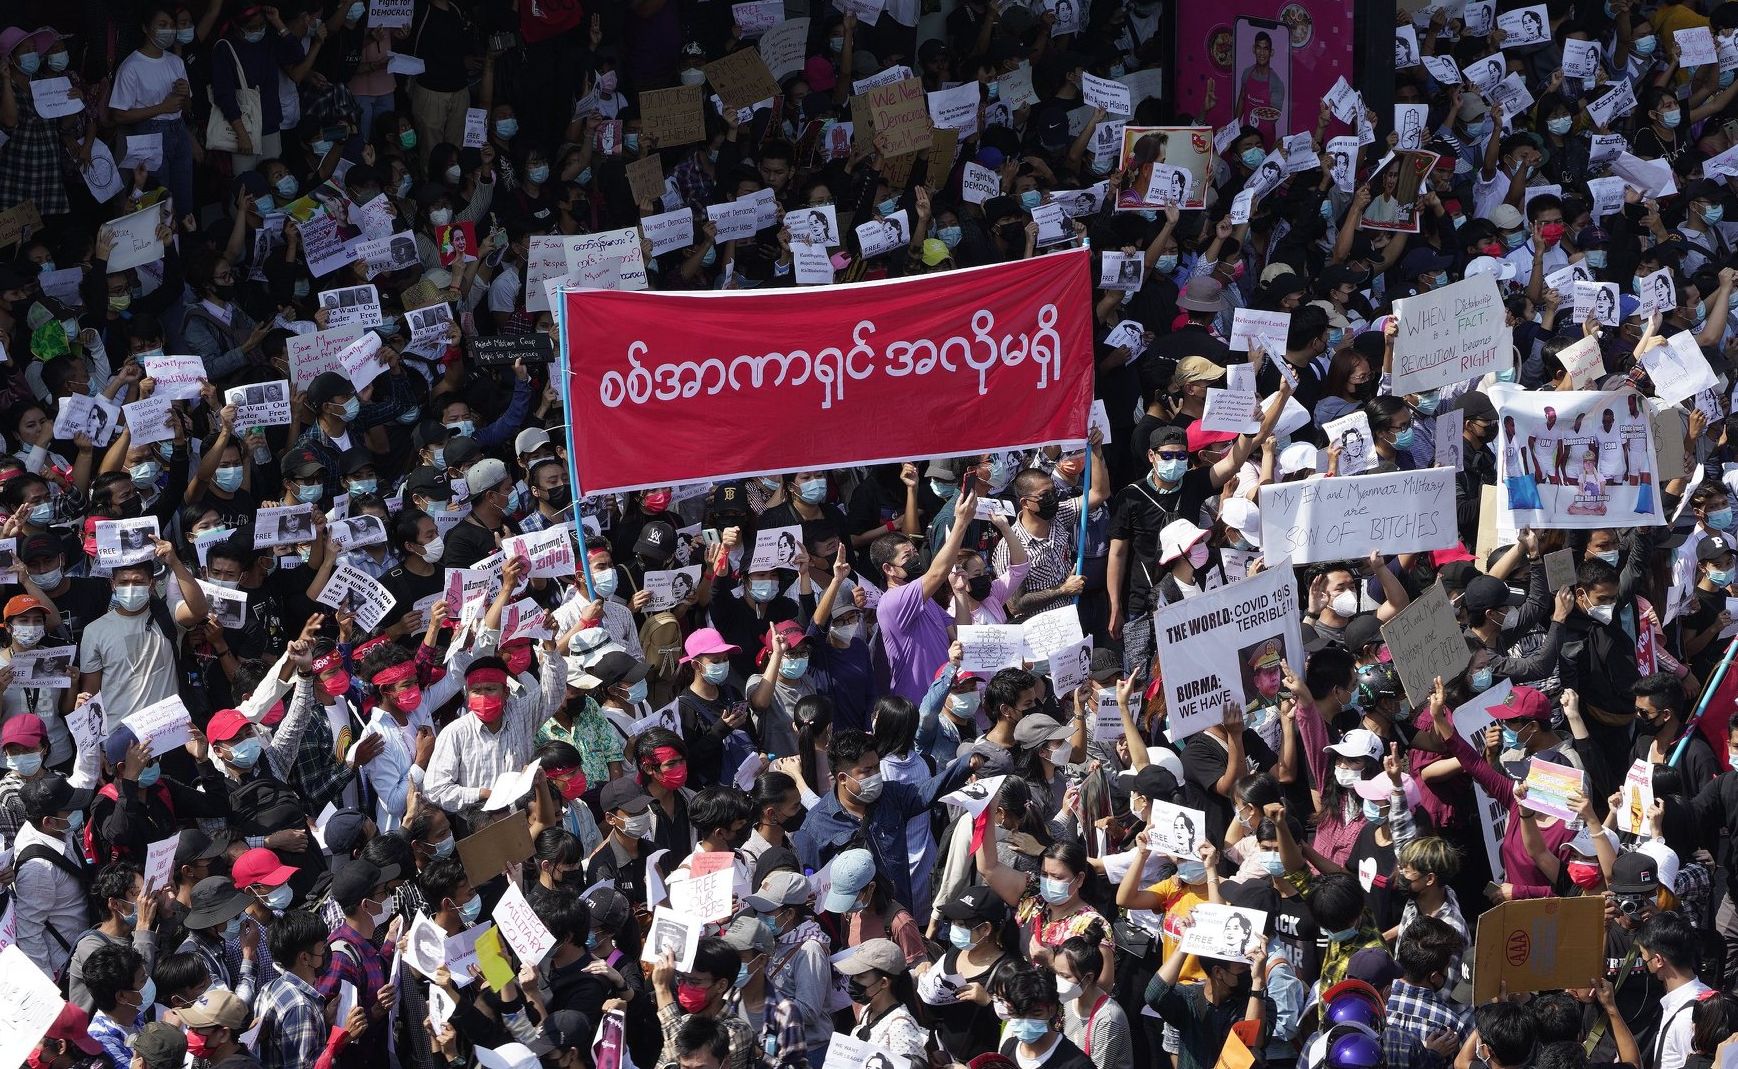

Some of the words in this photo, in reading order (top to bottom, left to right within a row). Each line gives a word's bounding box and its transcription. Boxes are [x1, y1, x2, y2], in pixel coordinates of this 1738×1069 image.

[1563, 62, 1579, 70] FREE
[1719, 56, 1734, 64] REE
[873, 86, 897, 108] We
[899, 82, 925, 100] Need
[1084, 92, 1095, 102] Min
[1109, 99, 1129, 113] Hlaing
[969, 168, 988, 181] Fight
[1150, 187, 1168, 196] FREE
[864, 243, 881, 253] FREE
[1102, 274, 1115, 282] FREE
[338, 306, 360, 315] Want
[363, 303, 380, 312] Our
[1575, 305, 1590, 313] FREE
[1642, 299, 1654, 310] FREE
[360, 311, 378, 320] Free
[1235, 316, 1257, 325] Release
[1268, 320, 1288, 328] Leader
[1404, 306, 1447, 338] WHEN
[292, 341, 312, 355] Save
[315, 333, 355, 352] Myanmar
[599, 320, 877, 410] စစ်အာဏာရှင်
[885, 302, 1062, 396] အလိုမရှိ
[1401, 345, 1457, 372] REVOLUTION
[1462, 335, 1493, 353] becomes
[1460, 346, 1497, 374] RIGHT
[294, 354, 320, 367] Justice
[297, 367, 321, 382] Reject
[245, 405, 268, 413] Want
[272, 401, 290, 410] Our
[235, 413, 258, 422] eader
[268, 409, 287, 417] Free
[241, 419, 257, 427] Aung
[279, 415, 290, 424] Kyi
[1539, 439, 1551, 447] UN
[1271, 492, 1294, 510] My
[1327, 490, 1346, 501] and
[1345, 482, 1401, 505] Myanmar
[1402, 476, 1446, 503] Military
[1343, 506, 1371, 517] are
[255, 532, 272, 541] FREE
[1286, 525, 1319, 556] SON
[1326, 524, 1360, 546] OF
[1368, 510, 1440, 541] BITCHES
[98, 547, 116, 556] FREE
[752, 556, 770, 564] FREE
[342, 565, 369, 584] Shame
[368, 580, 379, 592] On
[380, 591, 392, 605] YOU
[335, 573, 349, 584] MIN
[348, 579, 367, 595] AUNG
[366, 590, 387, 612] HLAING
[363, 606, 379, 622] Military
[1166, 623, 1189, 646] THE
[1187, 607, 1234, 638] WORLD:
[1233, 597, 1271, 618] COVID
[1270, 588, 1284, 609] 19
[1234, 598, 1295, 633] TERRIBLE!!
[1057, 674, 1074, 685] FREE
[1408, 666, 1426, 695] SON
[1175, 673, 1222, 704] BURMA:
[1177, 701, 1200, 720] WE
[1200, 689, 1233, 714] HAVE
[1150, 831, 1169, 843] FREE
[518, 899, 548, 940] REJECT
[504, 901, 545, 954] MILITARY
[502, 920, 527, 957] COUP
[1188, 932, 1214, 945] FREE
[1509, 933, 1528, 963] AAA
[450, 954, 464, 964] Need
[835, 1042, 844, 1050] WE
[843, 1044, 859, 1054] WANT
